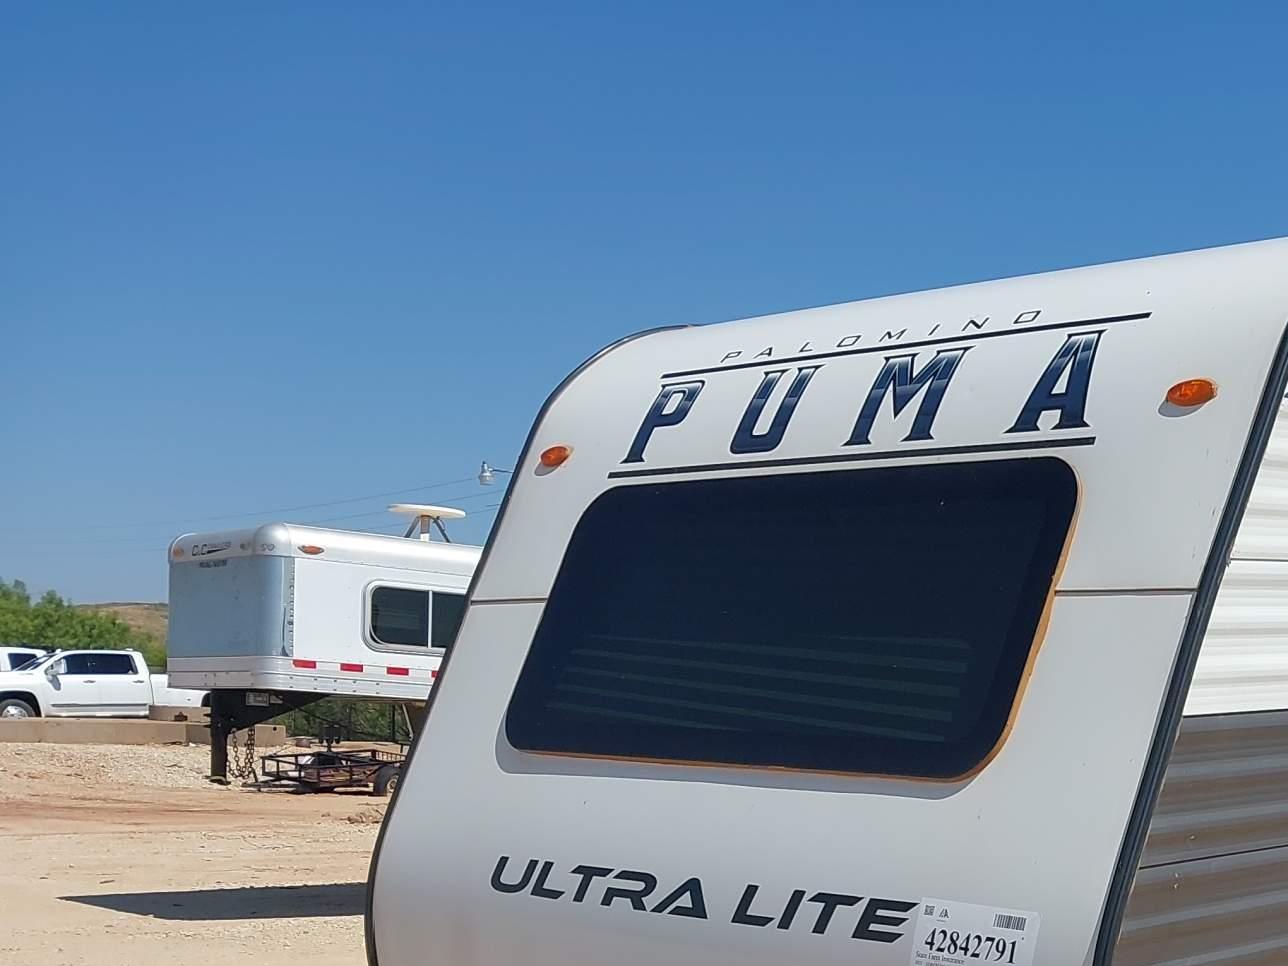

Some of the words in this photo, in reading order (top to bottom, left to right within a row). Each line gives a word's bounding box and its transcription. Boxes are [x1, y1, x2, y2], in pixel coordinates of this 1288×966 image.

[721, 309, 1043, 364] PALOMINO
[619, 328, 1108, 465] PUMA
[489, 854, 709, 920] ULTRA
[730, 883, 920, 944] LITE
[924, 927, 1018, 965] 42842791
